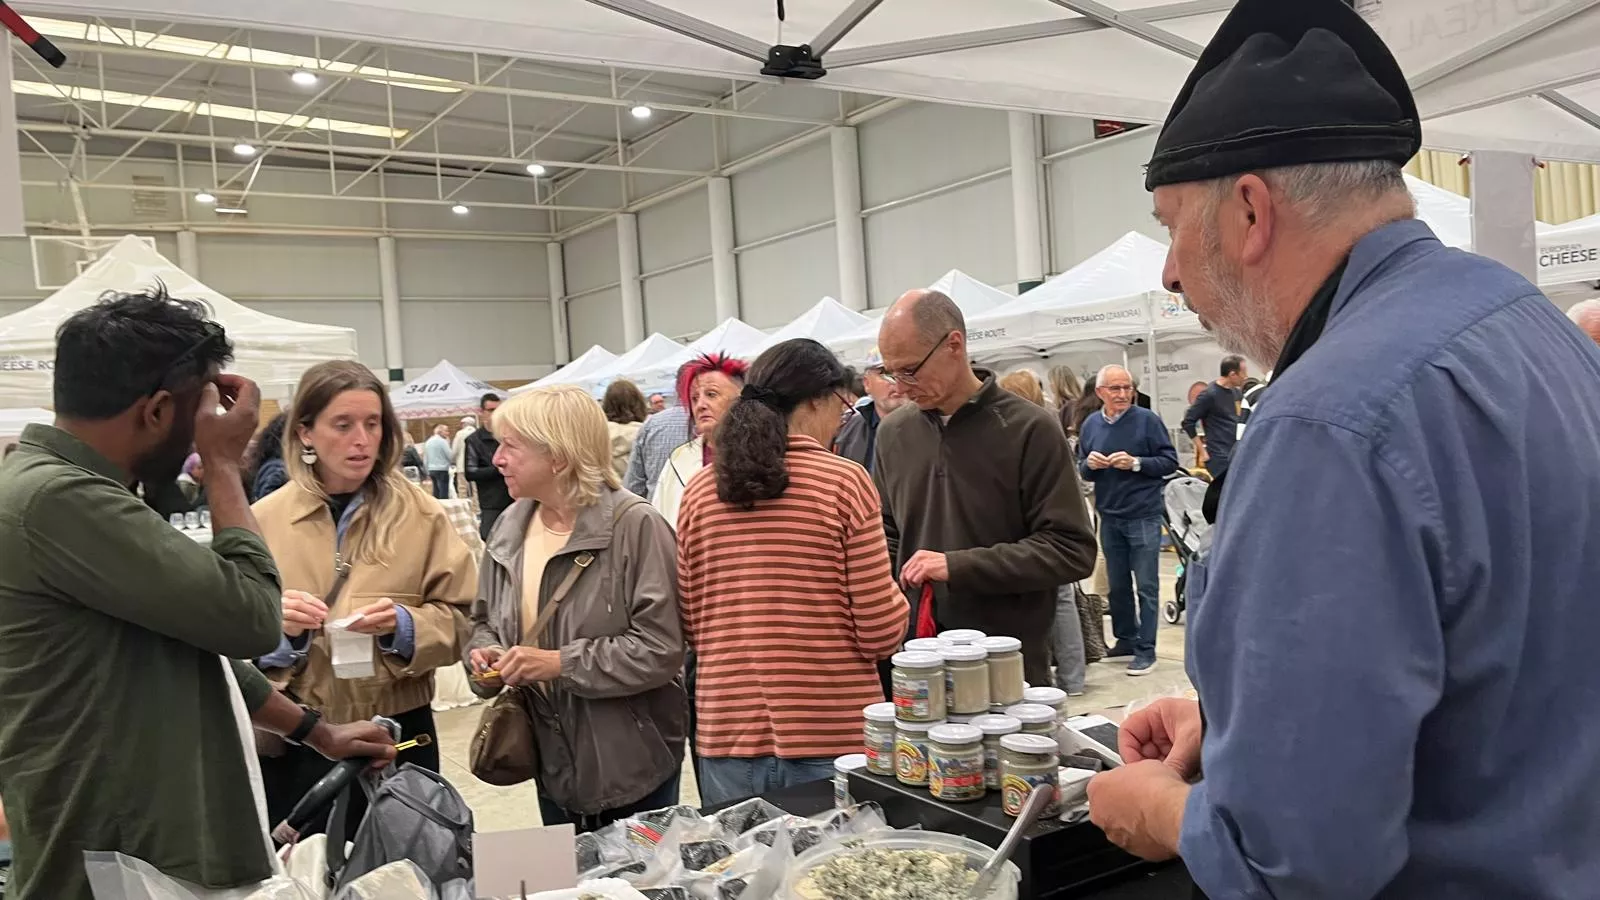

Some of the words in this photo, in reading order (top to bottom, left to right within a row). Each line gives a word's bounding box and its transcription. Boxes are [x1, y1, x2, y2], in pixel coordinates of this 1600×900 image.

[1539, 248, 1598, 267] CHEESE
[967, 331, 984, 341] EESE
[985, 328, 1006, 338] ROUTE
[0, 360, 34, 371] EESE
[406, 382, 450, 394] 3404
